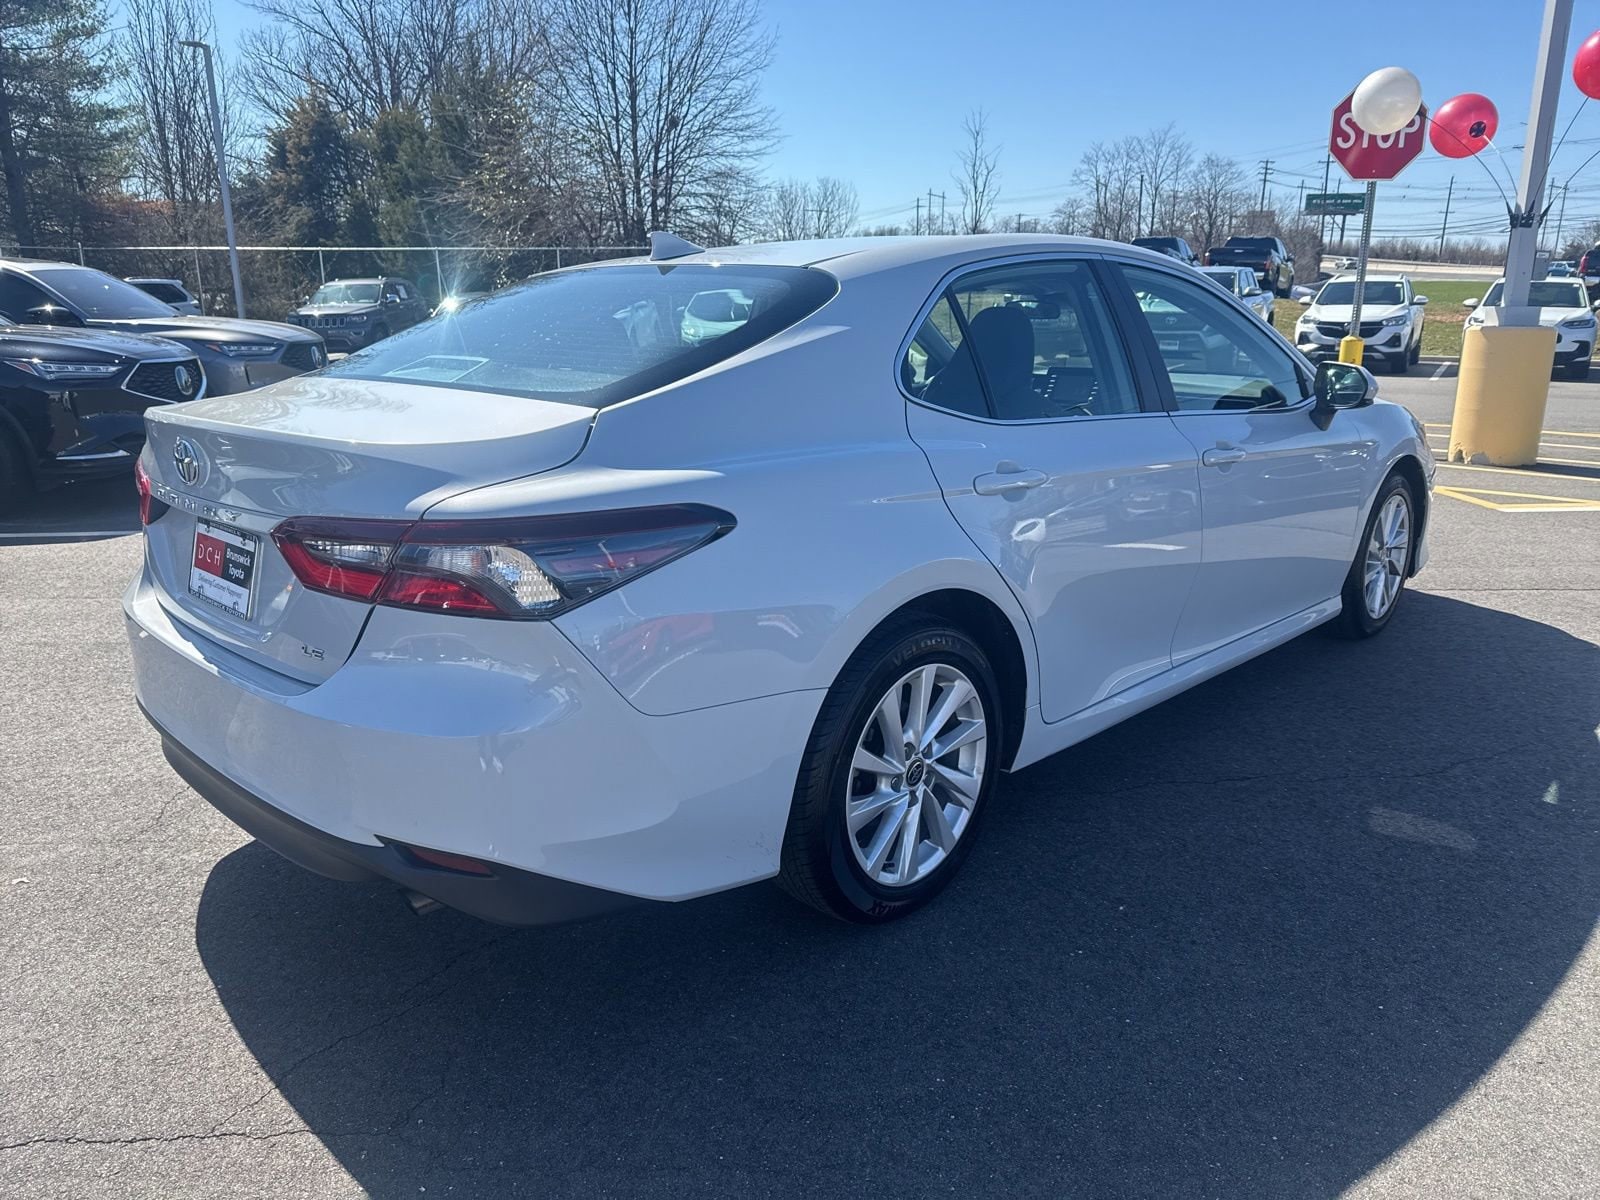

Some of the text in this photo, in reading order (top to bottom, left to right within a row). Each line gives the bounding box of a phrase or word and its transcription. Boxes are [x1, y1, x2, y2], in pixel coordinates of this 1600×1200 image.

[226, 547, 251, 566] Brunswick
[228, 564, 245, 579] Toyota
[226, 606, 245, 619] TOYOTA
[301, 642, 325, 661] LE
